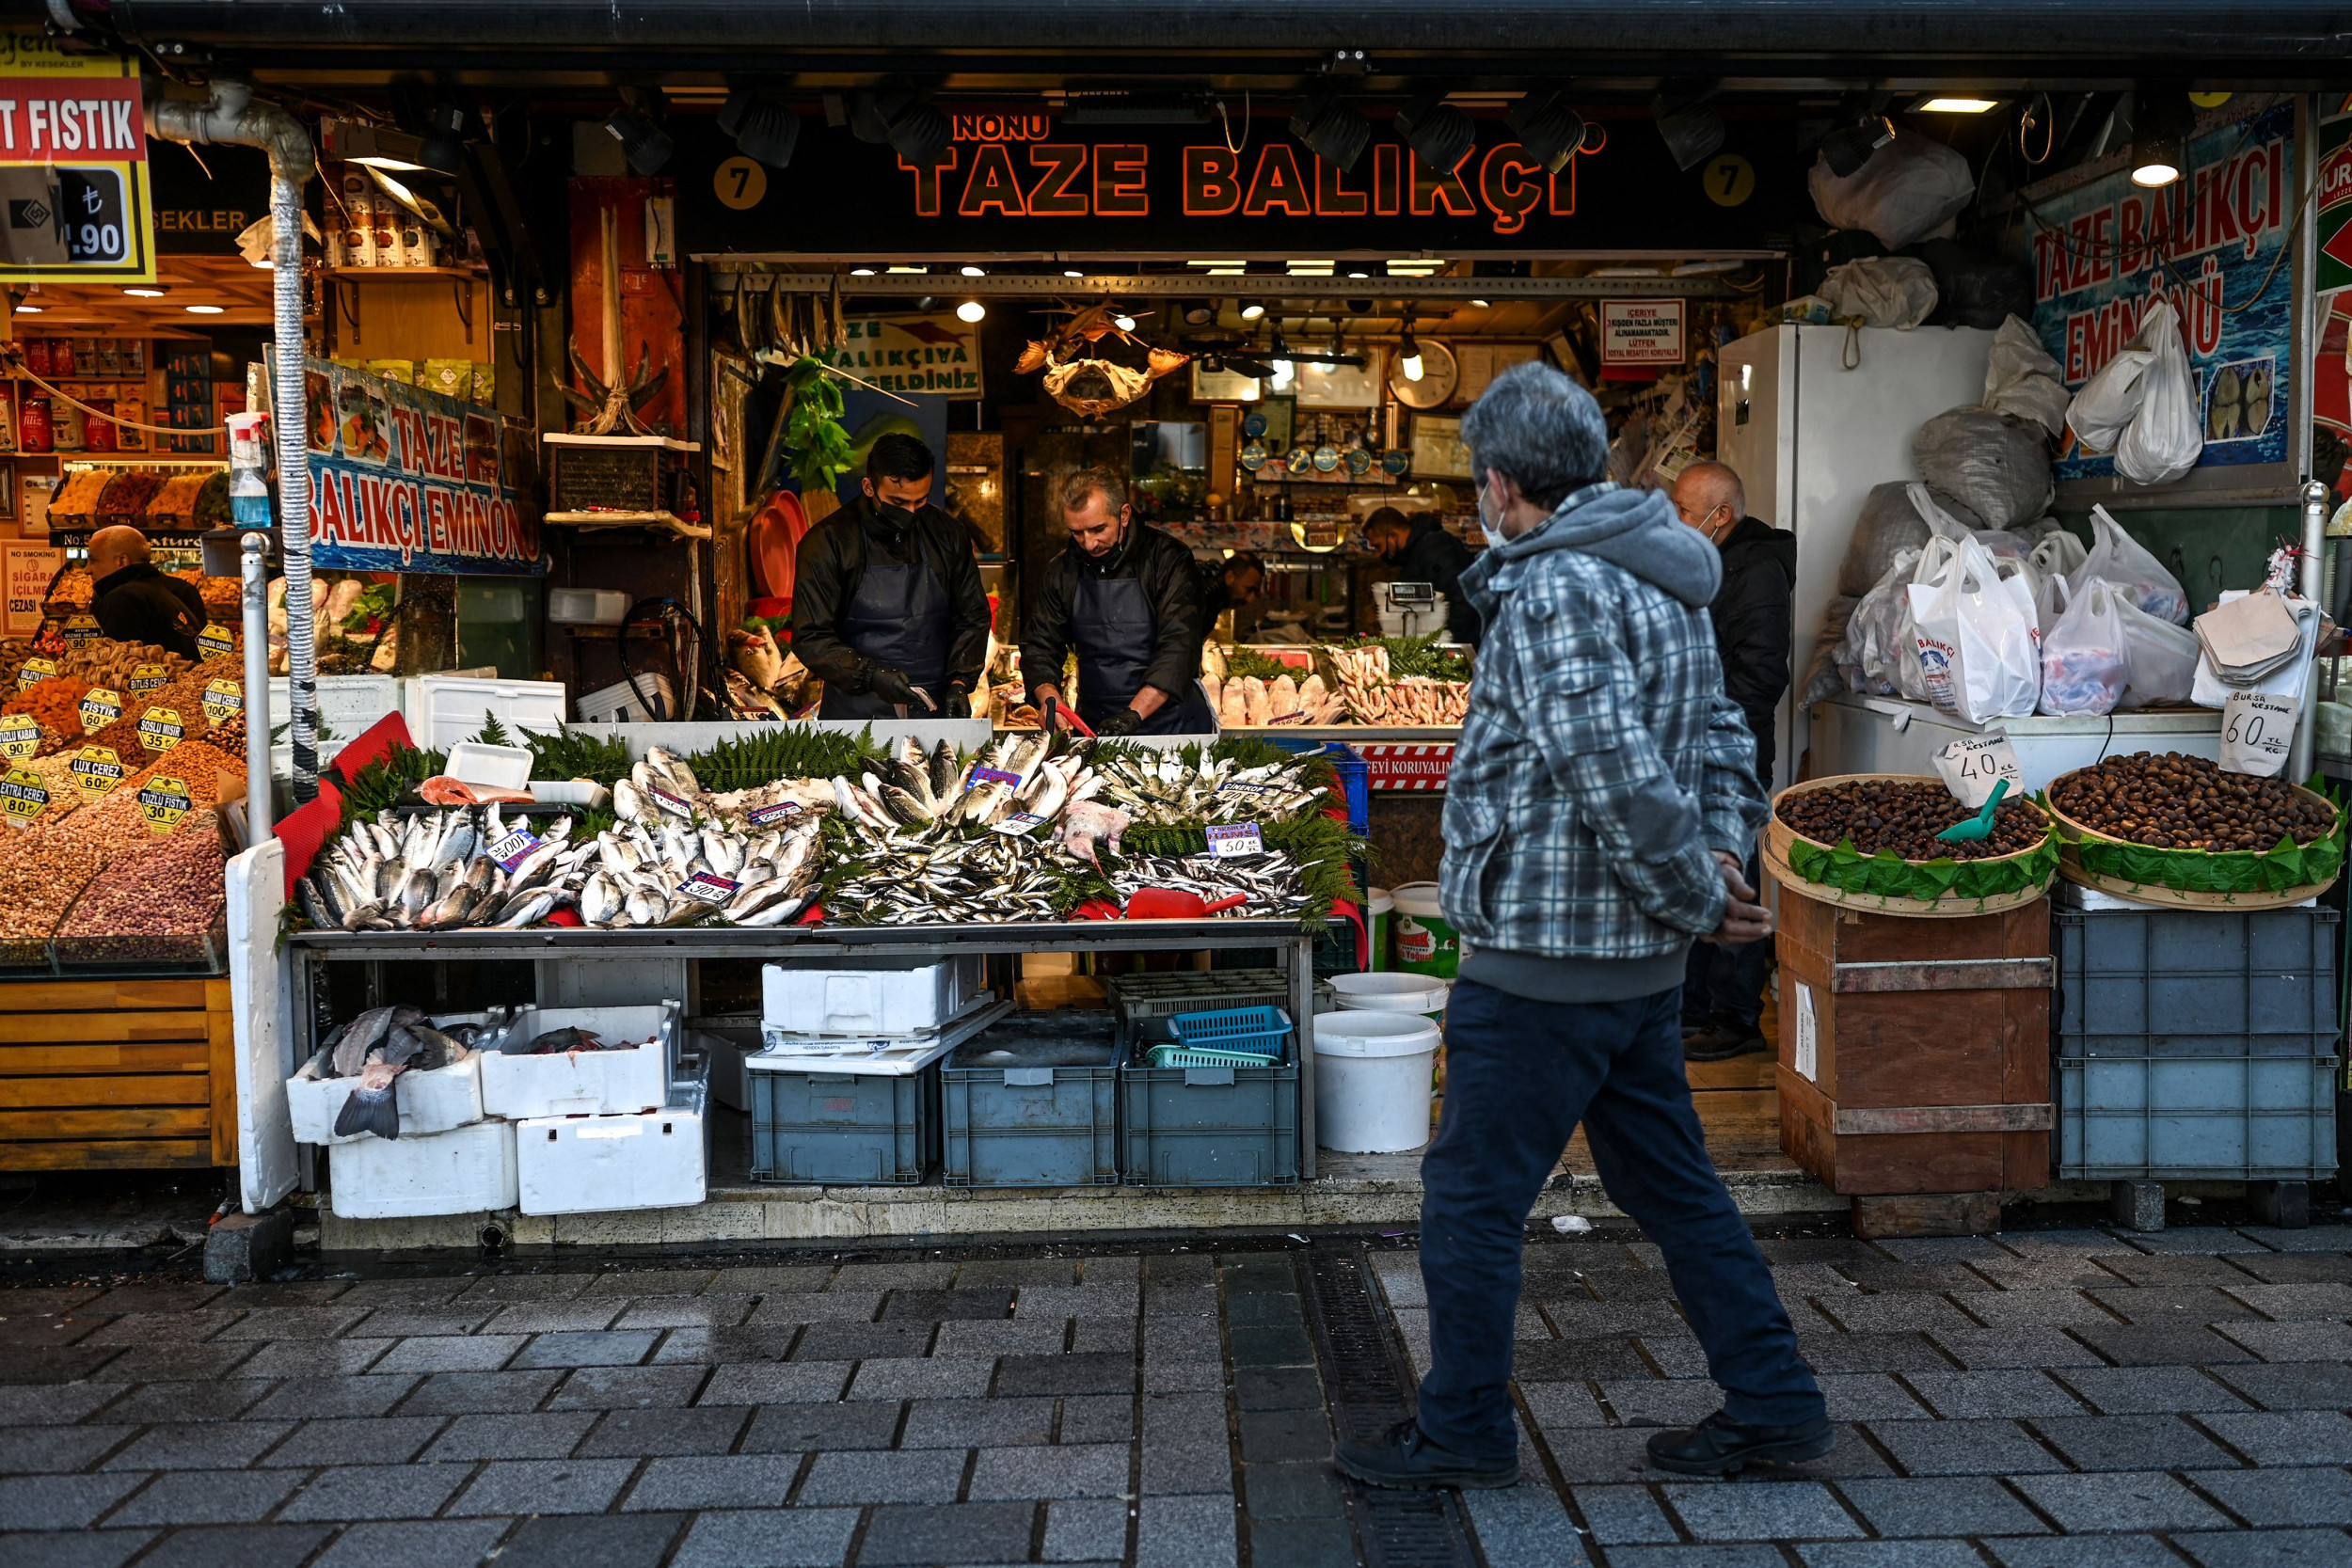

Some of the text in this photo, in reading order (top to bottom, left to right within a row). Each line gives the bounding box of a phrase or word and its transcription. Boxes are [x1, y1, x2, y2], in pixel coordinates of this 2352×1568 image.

[21, 60, 84, 69] BY KESEKLER
[27, 99, 137, 150] FISTIK
[729, 167, 751, 198] 7
[1718, 164, 1740, 195] 7
[2318, 163, 2352, 197] UR
[898, 143, 1577, 234] TAZE BALIKÇI
[2033, 139, 2282, 303] TAZE BALIKÇI
[65, 223, 119, 255] .90
[1628, 339, 1656, 347] LÜTFEN
[837, 347, 967, 371] ALIKÇIYA
[390, 405, 465, 483] TAZE
[12, 583, 46, 597] İÇİLME
[9, 599, 36, 612] CEZASI
[72, 639, 86, 647] 90
[1917, 638, 1955, 658] BALIKÇI
[2233, 691, 2265, 703] BURSA
[83, 702, 117, 717] FISTIK
[207, 705, 226, 716] 100
[2251, 702, 2292, 714] KESTANE
[87, 714, 100, 724] 60
[17, 728, 38, 740] KABAK
[141, 720, 162, 734] SOSLU
[2226, 713, 2265, 746] 60
[147, 734, 163, 747] 35
[1966, 736, 2006, 752] KESTANE
[9, 743, 24, 754] 90
[73, 759, 90, 773] LUX
[1961, 753, 1995, 780] 40
[85, 776, 102, 788] 60
[0, 782, 22, 799] EXTRA
[8, 800, 25, 812] 80
[141, 792, 188, 810] TUZLU FISTIK
[148, 805, 165, 818] 30
[503, 834, 525, 853] 100
[1225, 840, 1245, 852] 50
